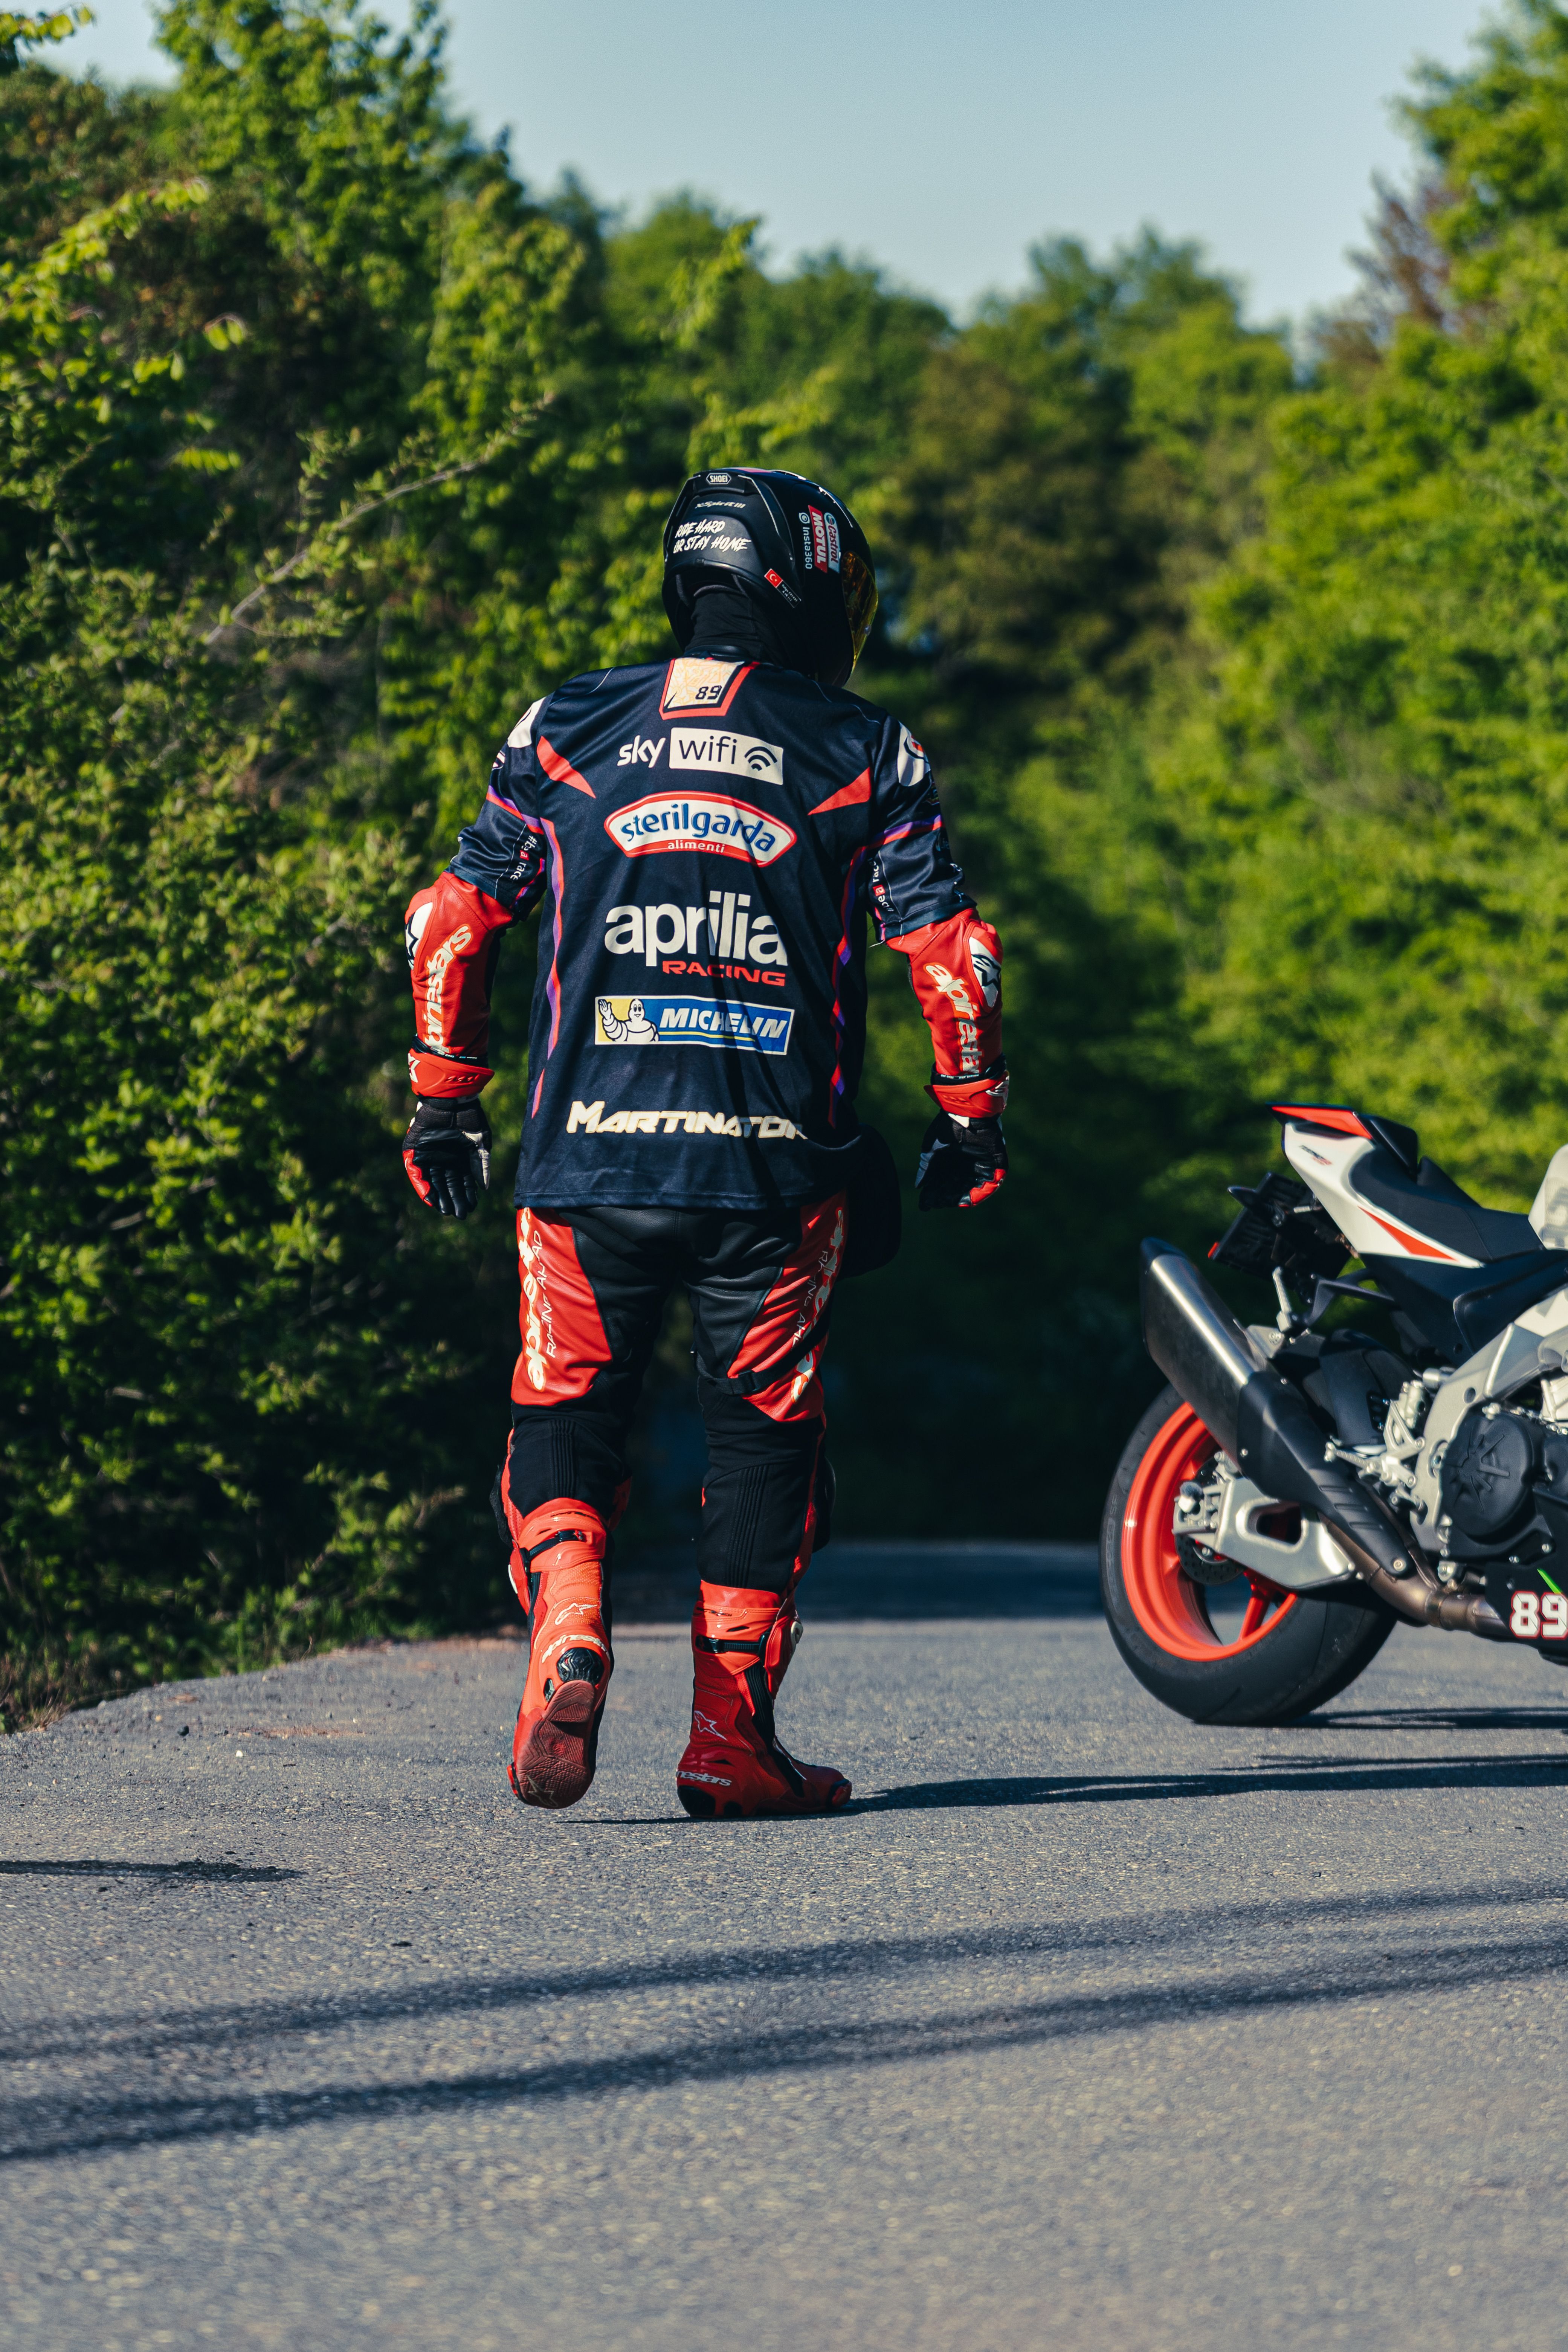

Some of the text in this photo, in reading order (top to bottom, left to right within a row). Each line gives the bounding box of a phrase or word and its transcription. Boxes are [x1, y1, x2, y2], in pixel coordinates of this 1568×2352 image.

[710, 474, 728, 482] SHOEI
[673, 534, 752, 554] OR STAY HOME
[674, 519, 725, 539] RIDE HARD
[812, 511, 826, 563] MOTUL
[828, 525, 838, 563] Castrol
[803, 527, 812, 569] Insta360
[695, 685, 722, 699] 89
[617, 735, 737, 768] sky wifi
[620, 803, 776, 852] sterilgarda
[667, 839, 725, 853] alimenti
[604, 890, 788, 967] aprilia
[662, 961, 786, 987] RACING
[660, 1007, 787, 1038] MICHELIN
[1510, 1590, 1568, 1639] 89
